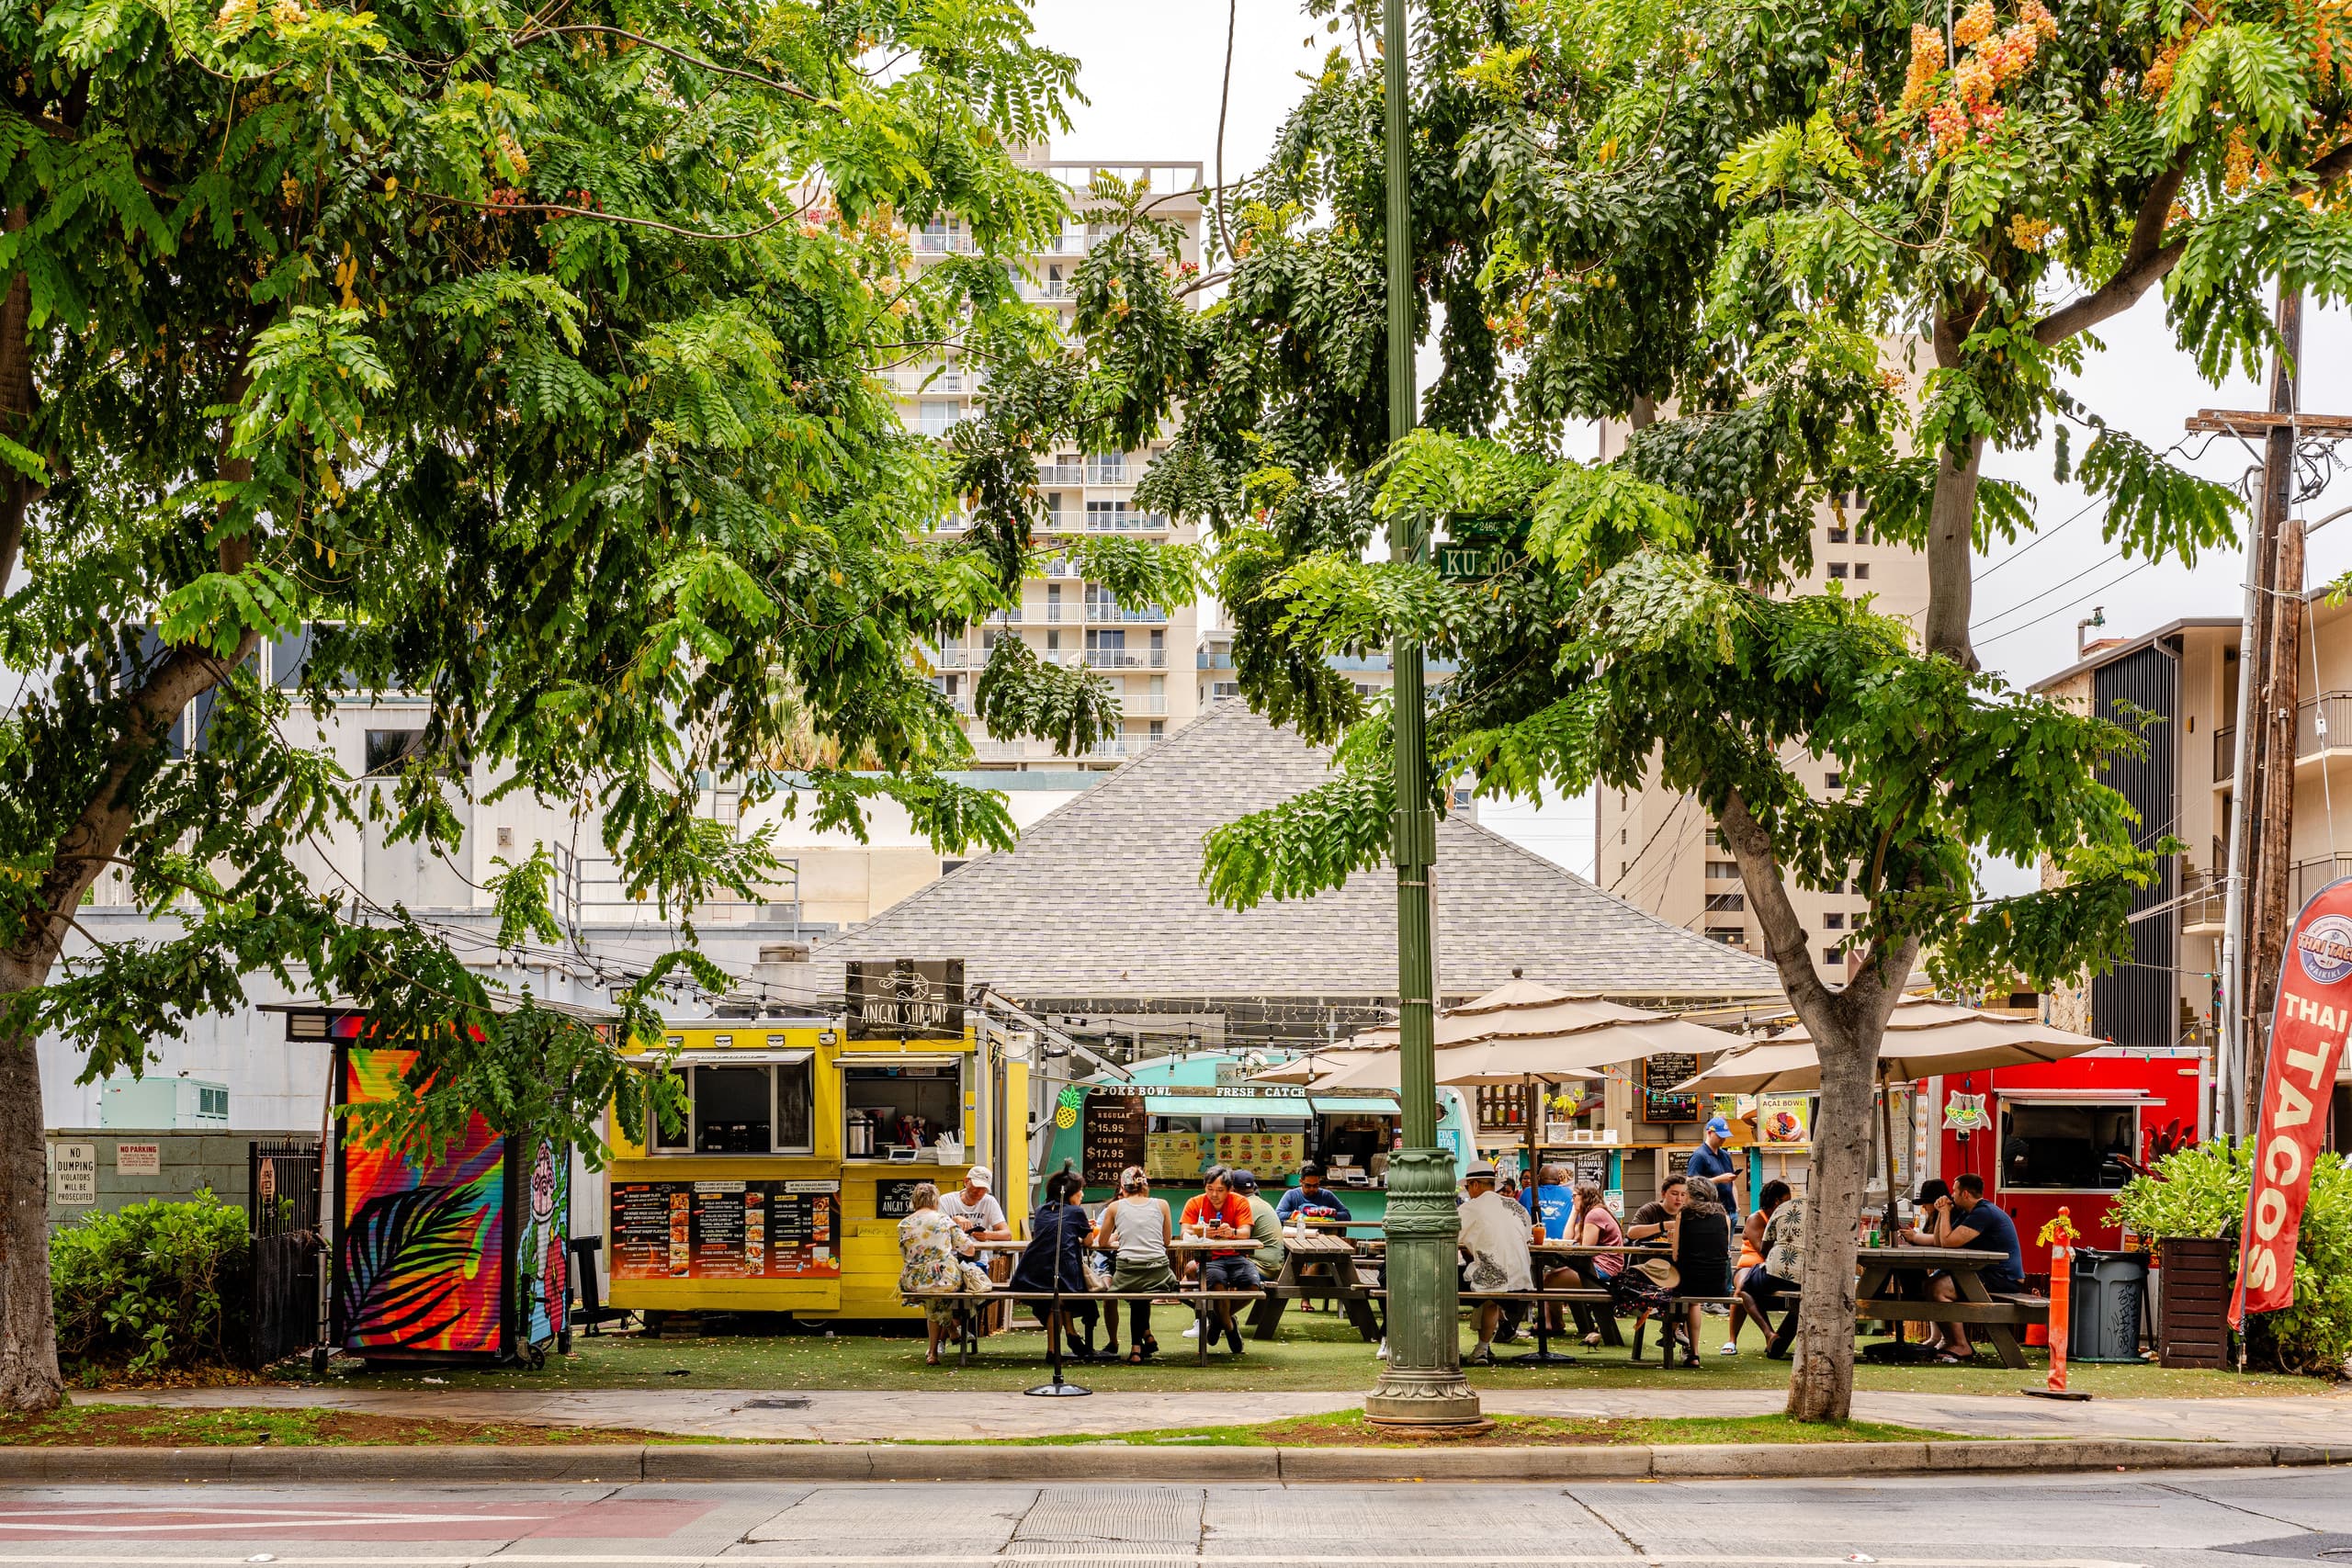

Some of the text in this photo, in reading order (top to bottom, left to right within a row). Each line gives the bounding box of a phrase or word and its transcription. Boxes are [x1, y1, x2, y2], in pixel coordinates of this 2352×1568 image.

[2299, 933, 2327, 955] THAI
[2307, 962, 2342, 979] WAIKIKI
[861, 1004, 899, 1024] ANGRY
[2284, 991, 2348, 1033] THAI
[1100, 1087, 1172, 1096] POKE BOWL
[1216, 1087, 1306, 1097] FRESH CATCH
[1087, 1121, 1125, 1134] $15.95
[1438, 1130, 1454, 1139] FIVE
[1437, 1139, 1456, 1148] STAR
[70, 1147, 81, 1158] NO
[120, 1145, 157, 1154] NO PARKING
[1087, 1145, 1125, 1159] $17.95
[57, 1161, 94, 1171] DUMPING
[2245, 1041, 2331, 1293] TACOS
[60, 1173, 91, 1181] VIOLATORS
[1086, 1168, 1119, 1182] $21.9
[64, 1183, 86, 1191] WILL BE
[882, 1201, 903, 1213] ANGRY
